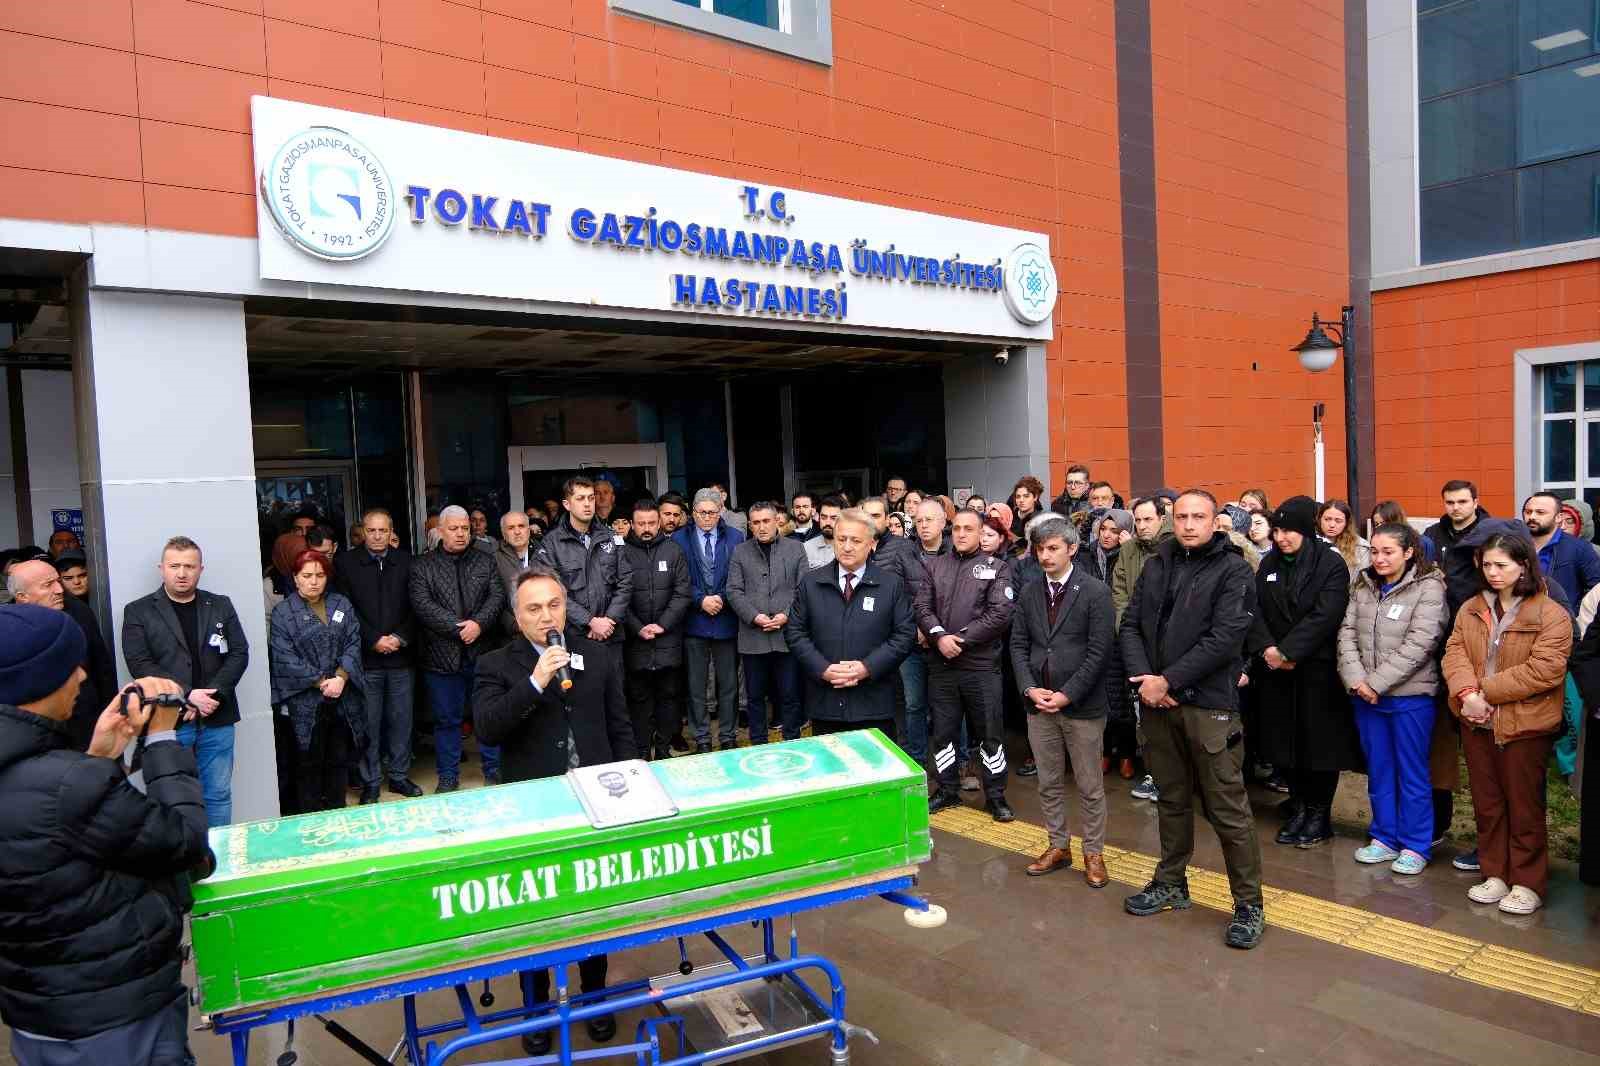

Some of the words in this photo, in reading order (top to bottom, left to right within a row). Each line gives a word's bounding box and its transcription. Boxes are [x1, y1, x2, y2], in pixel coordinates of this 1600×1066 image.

[280, 185, 307, 231] TOKAT
[740, 185, 796, 224] T.C.
[322, 233, 354, 247] 1992
[406, 184, 552, 239] TOKAT
[848, 237, 1004, 292] ÜNİVERSİTESİ
[671, 273, 848, 318] HASTANESİ
[432, 863, 562, 920] TOKAT
[572, 817, 775, 894] BELEDİYESİ
